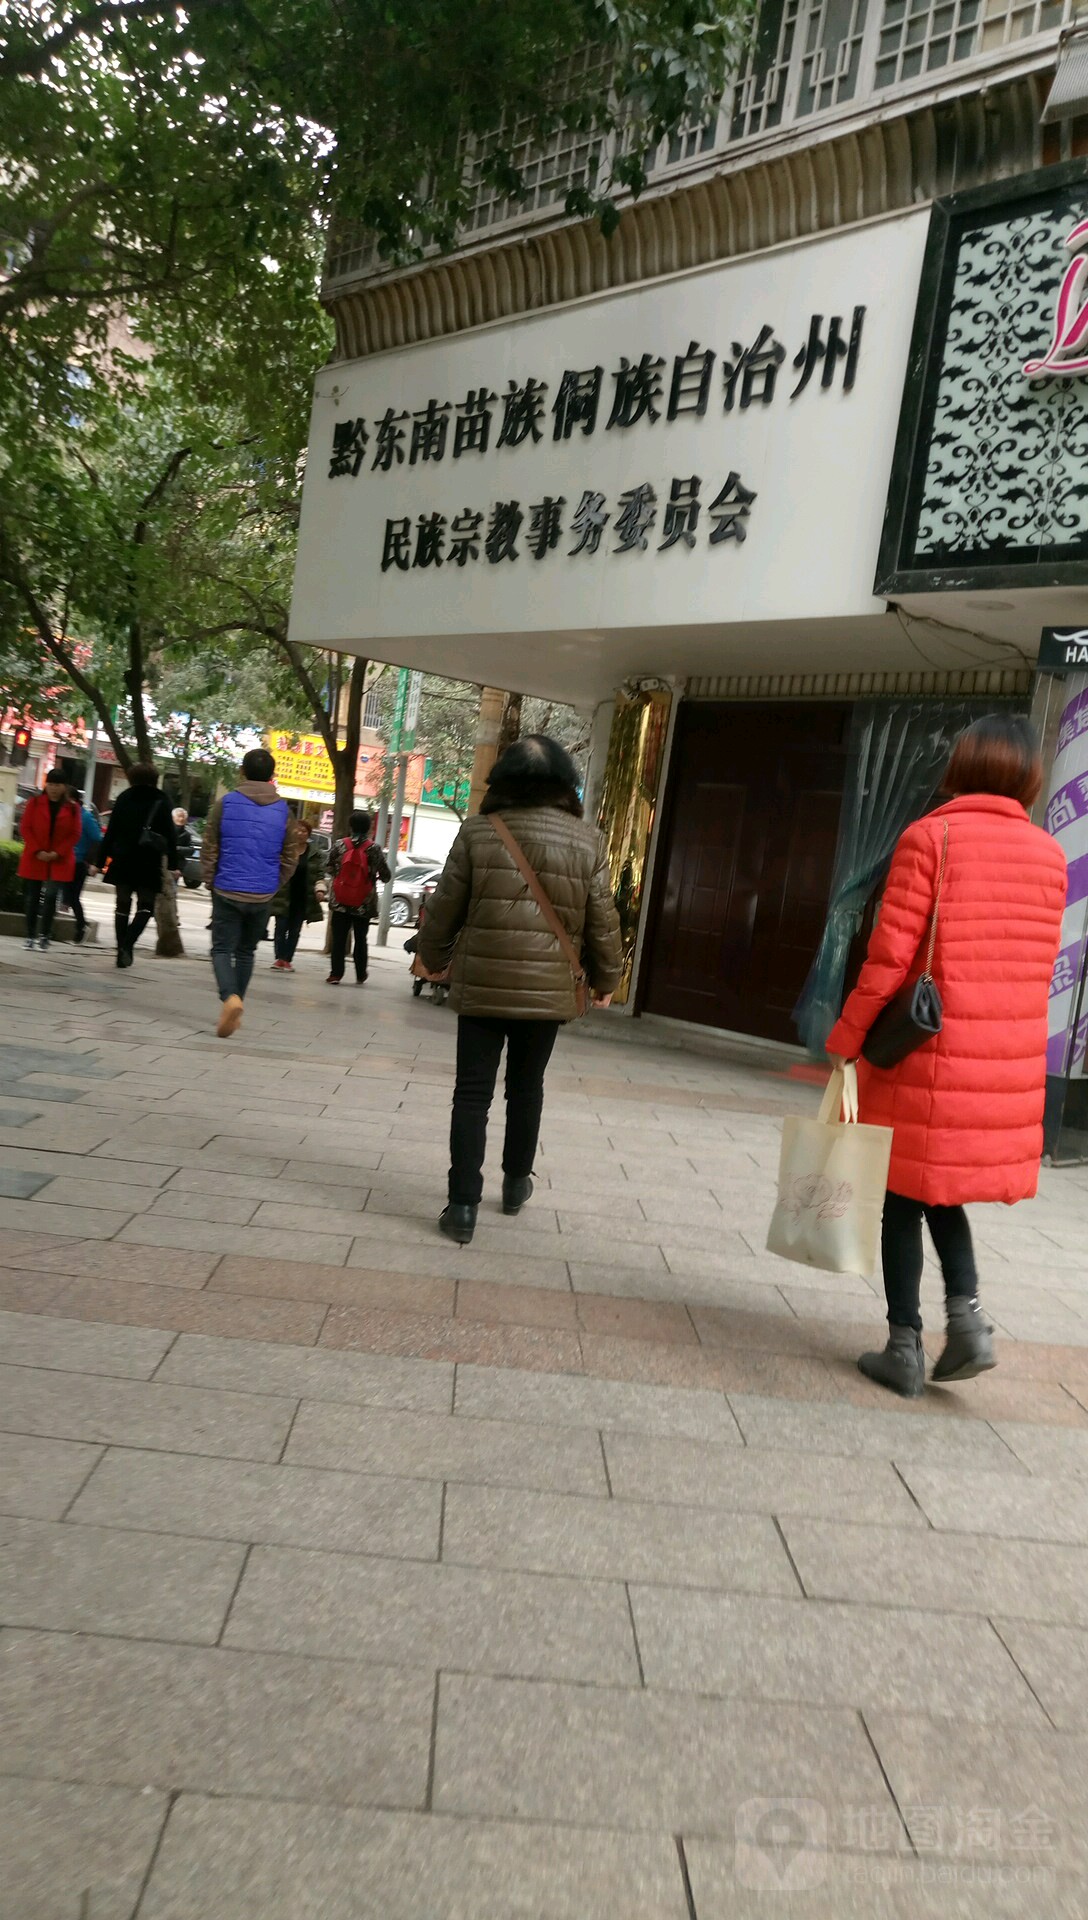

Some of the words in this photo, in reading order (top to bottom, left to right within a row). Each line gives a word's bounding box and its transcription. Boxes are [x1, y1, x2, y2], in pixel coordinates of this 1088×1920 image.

[328, 305, 867, 478] 黔东南苗族侗族自治州
[381, 471, 758, 573] 民族宗教事务委员会
